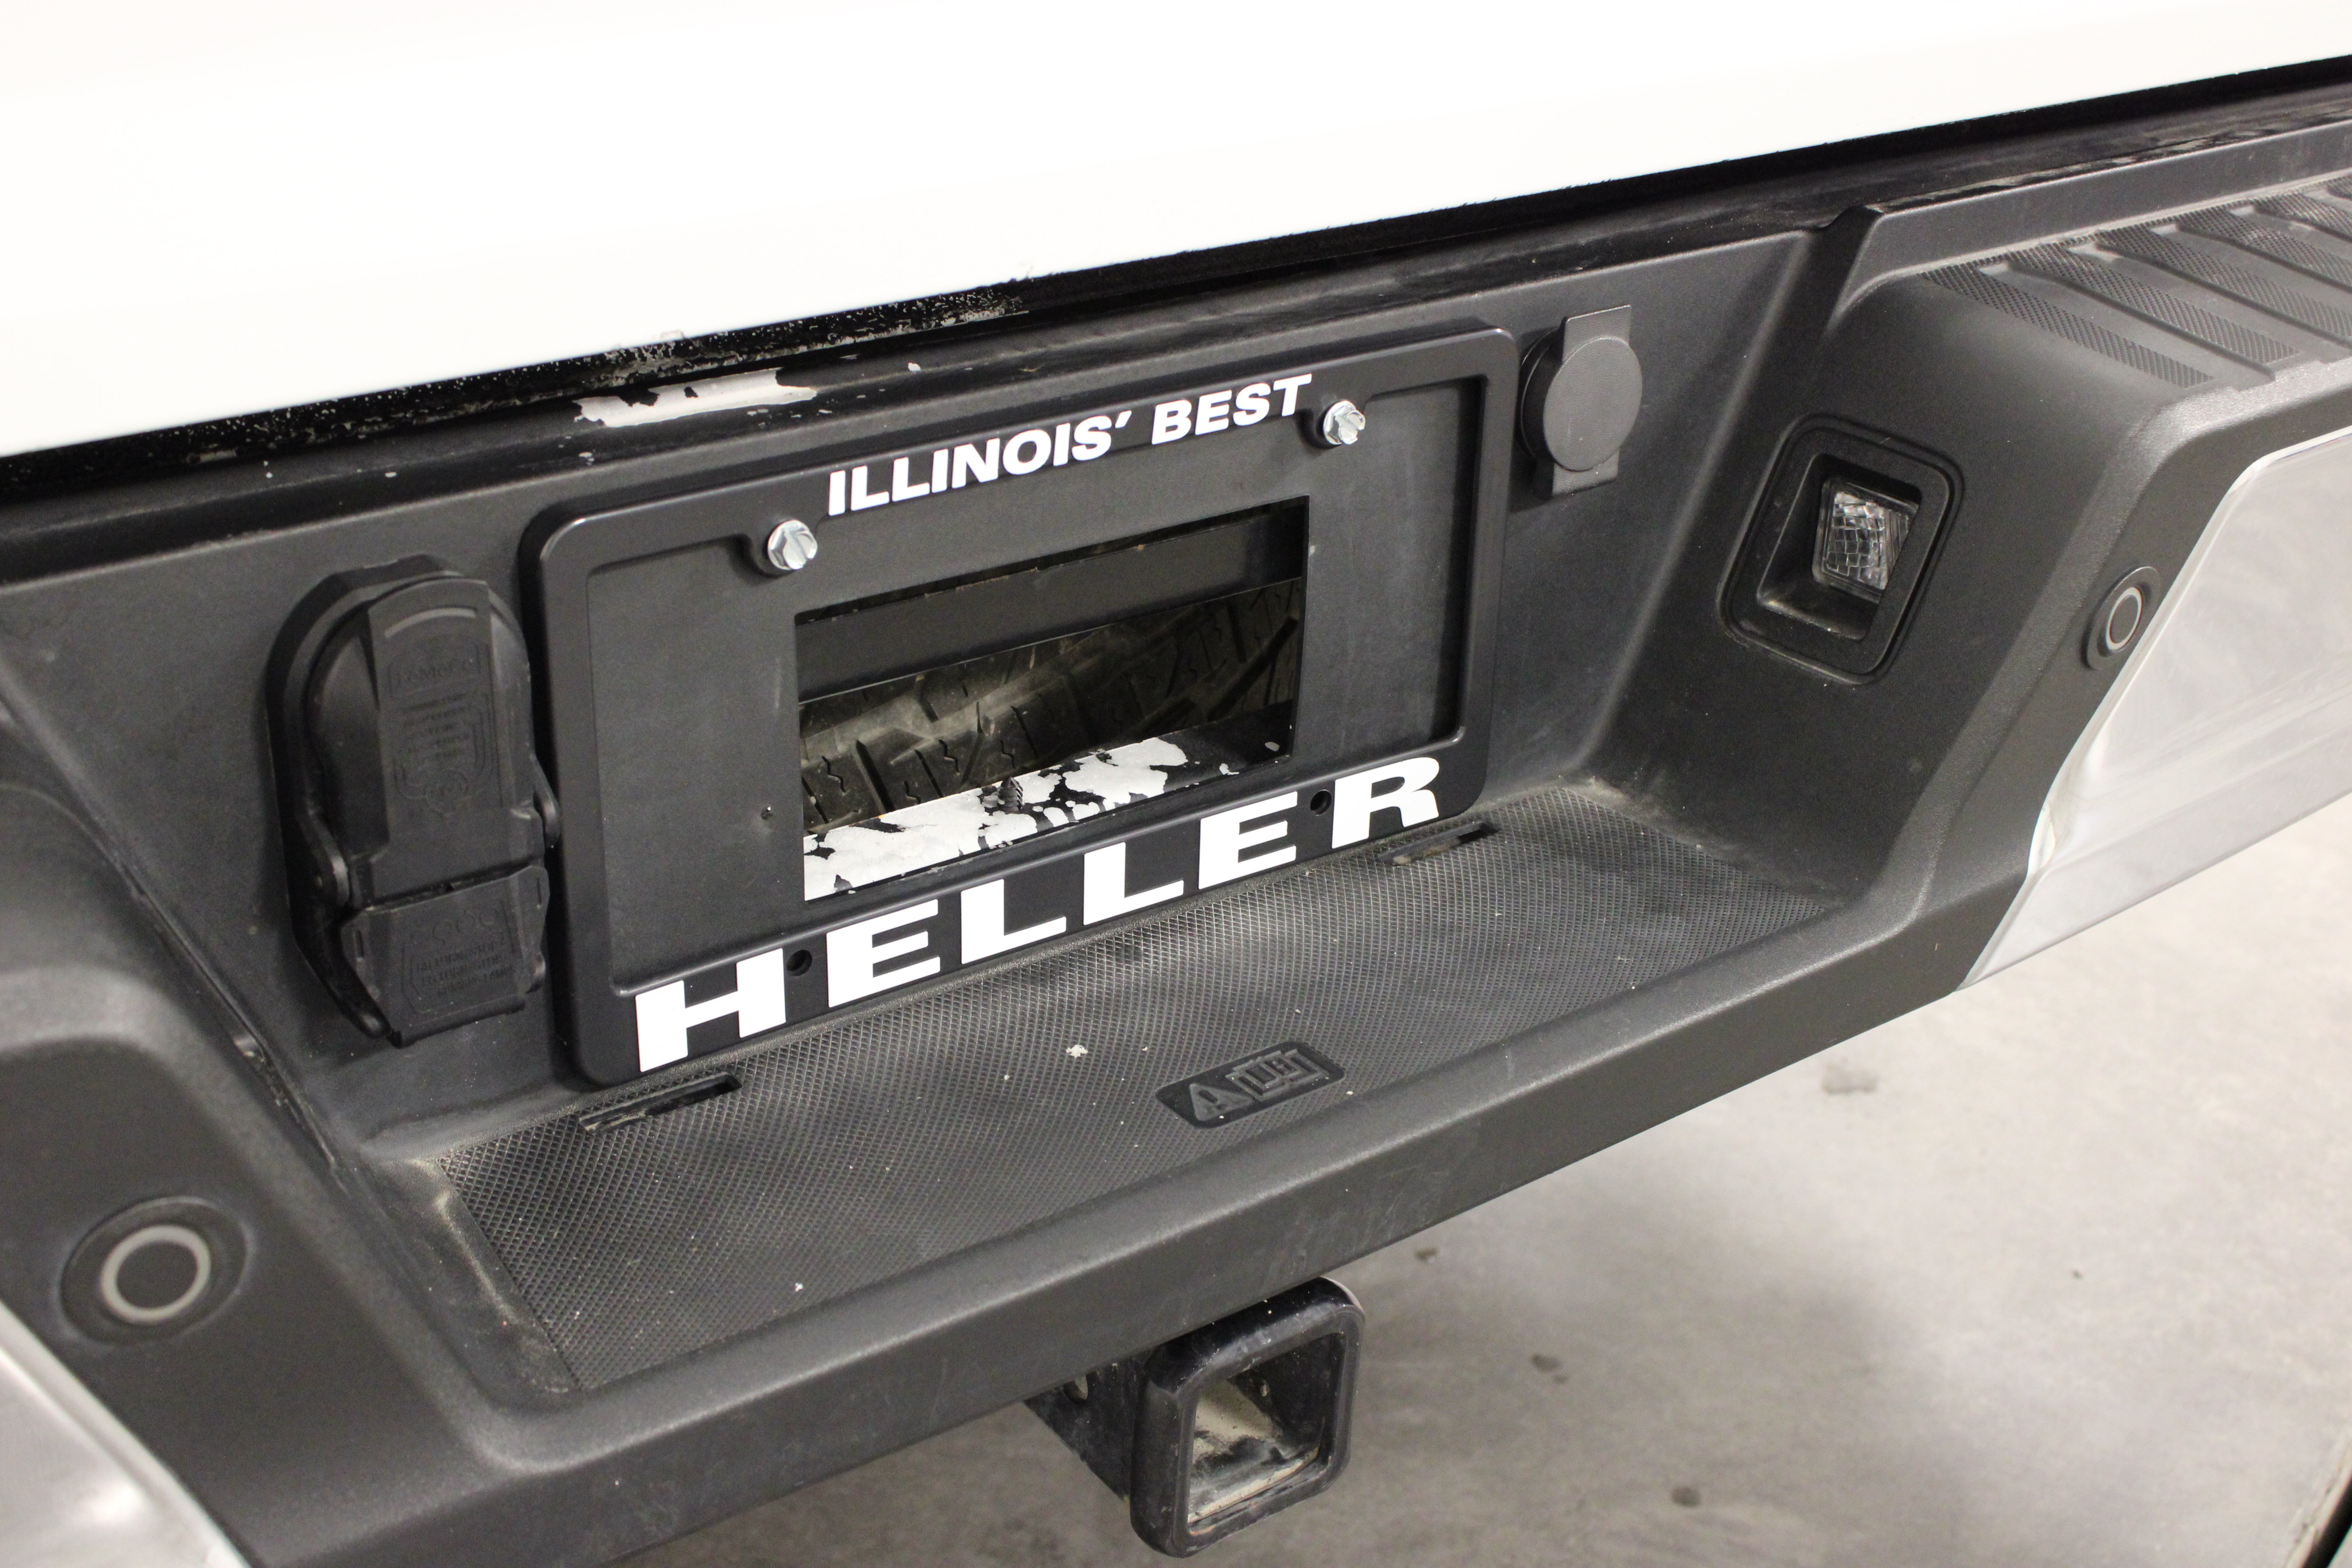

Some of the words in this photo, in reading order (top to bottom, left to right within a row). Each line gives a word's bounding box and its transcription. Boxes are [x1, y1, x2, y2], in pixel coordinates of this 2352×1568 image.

[829, 410, 1132, 516] ILLINOIS'
[1152, 373, 1312, 445] BEST
[635, 757, 1439, 1072] HELLER
